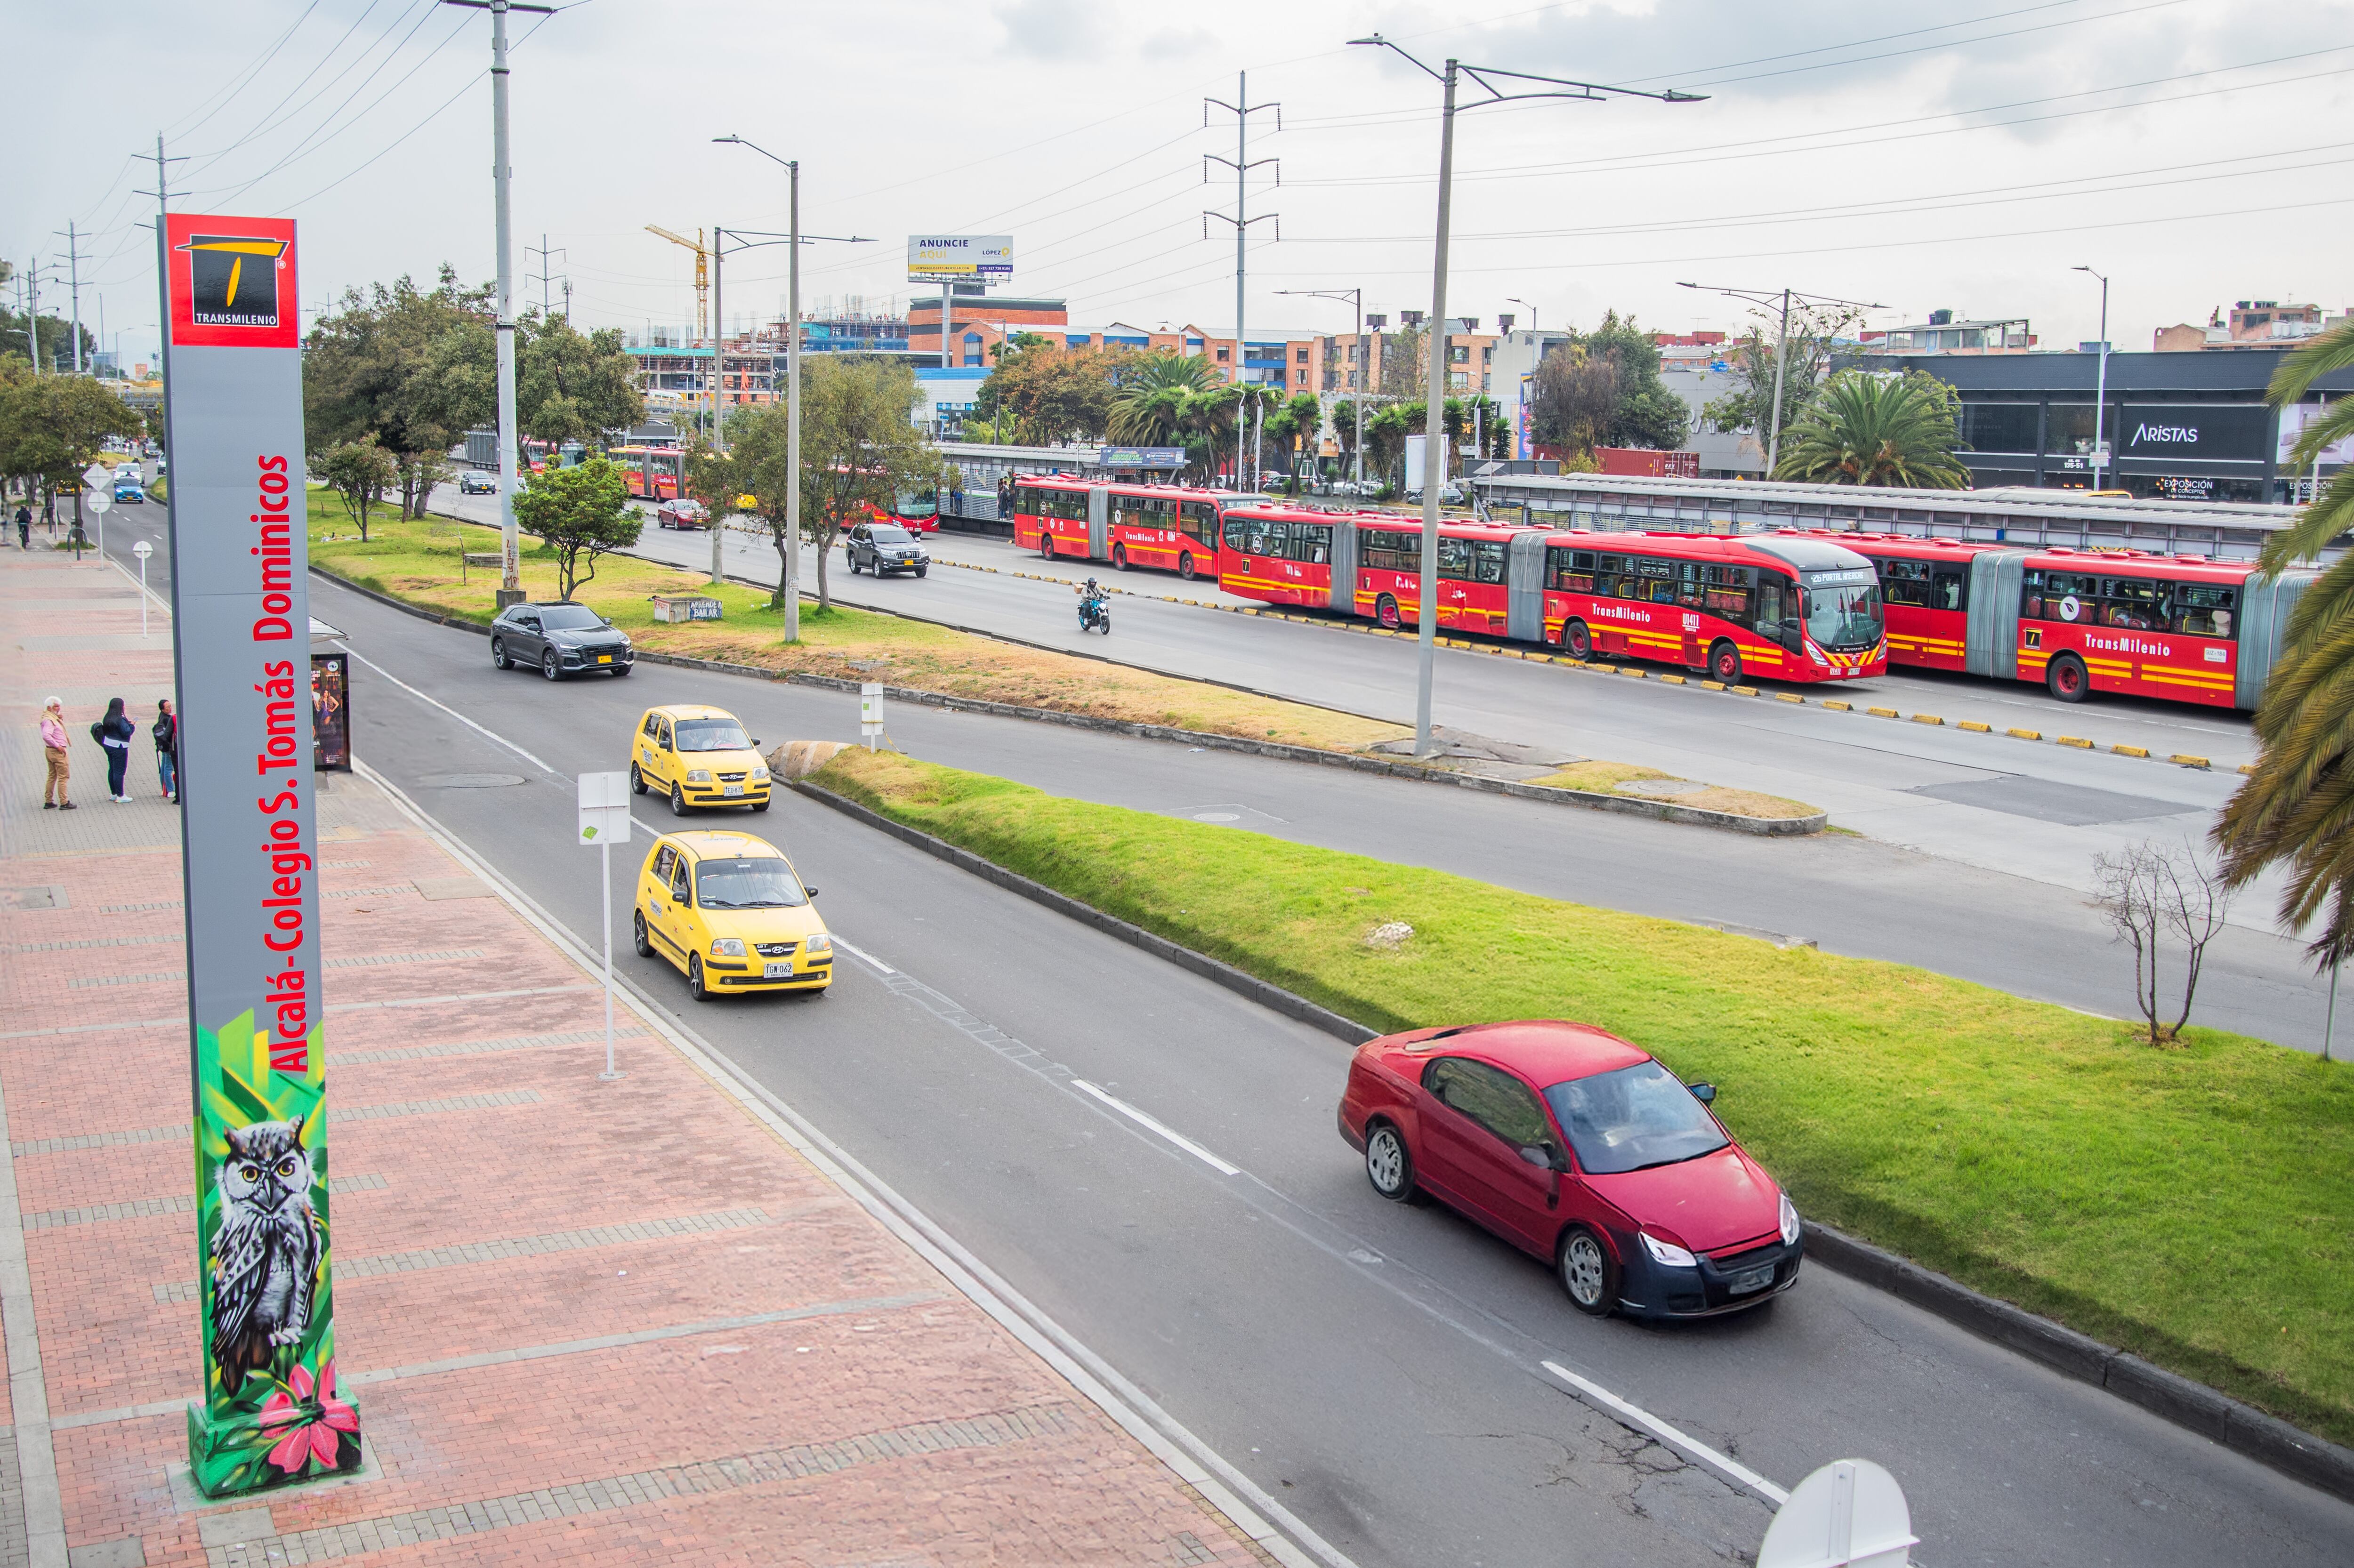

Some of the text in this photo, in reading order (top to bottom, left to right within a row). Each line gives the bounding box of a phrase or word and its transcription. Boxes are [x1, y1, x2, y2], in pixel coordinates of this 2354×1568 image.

[919, 249, 946, 260] AQUÍ
[196, 313, 276, 325] TRANSMILENIO
[2164, 480, 2213, 489] EXPOSICIÓN
[1126, 531, 1155, 542] TransMilenio
[1822, 573, 1842, 581] PORTAL
[1843, 571, 1863, 580] AMERICAS
[693, 609, 717, 618] BAILAR
[1593, 603, 1650, 622] TransMilenio
[1683, 613, 1699, 627] U1411
[2085, 634, 2170, 656] TransMilenio
[250, 455, 312, 1073] Alcalá-Colegio S. Tomás Dominicos
